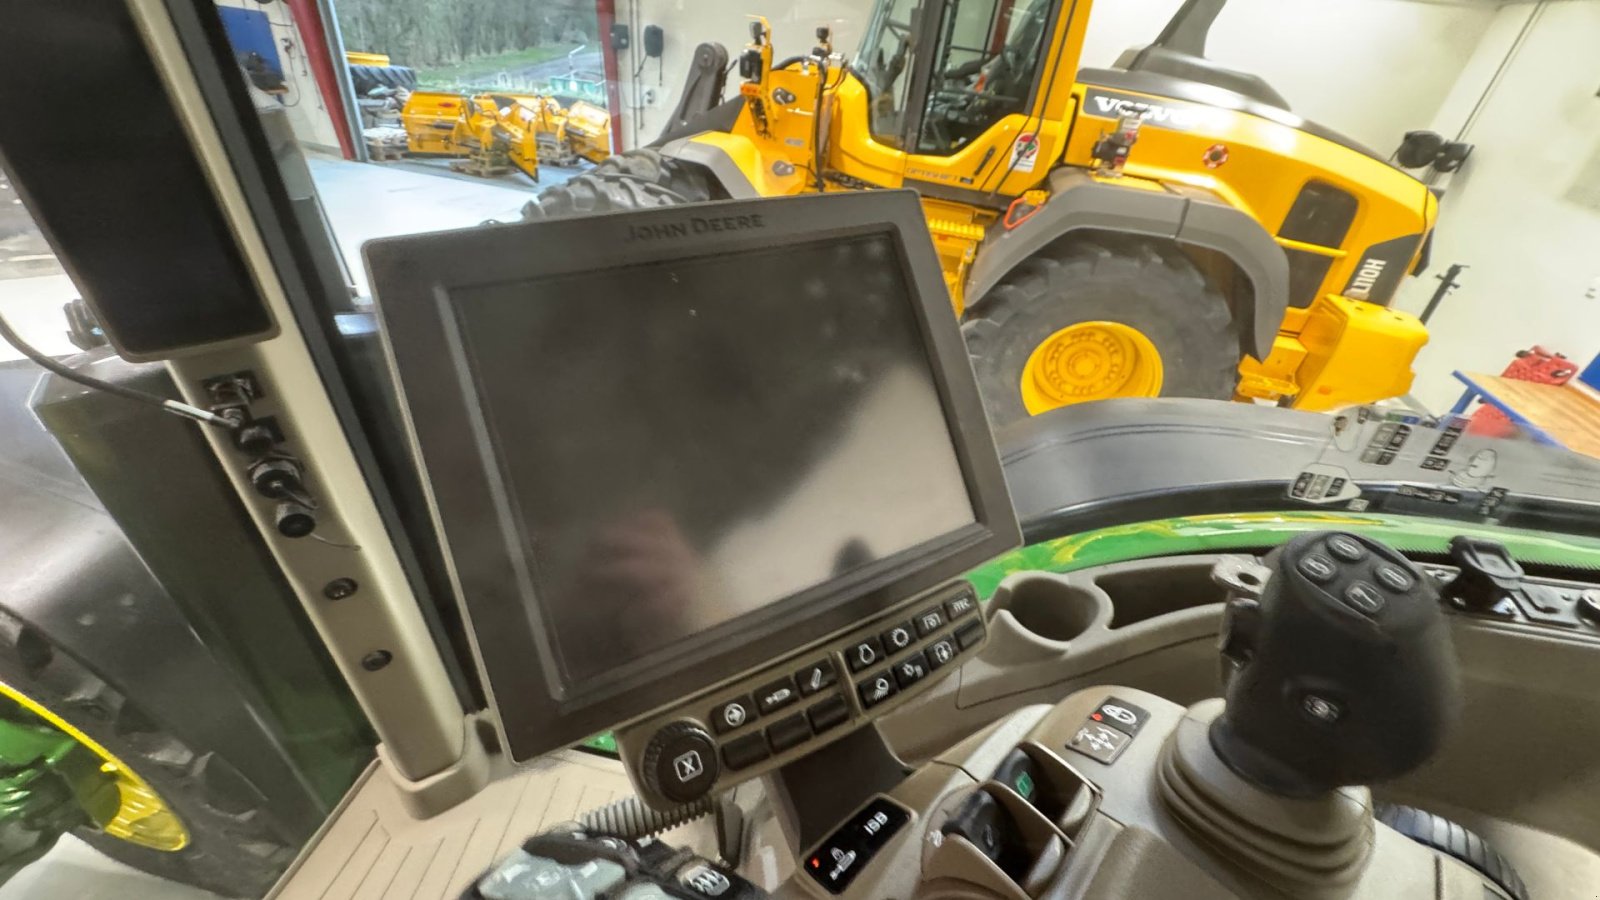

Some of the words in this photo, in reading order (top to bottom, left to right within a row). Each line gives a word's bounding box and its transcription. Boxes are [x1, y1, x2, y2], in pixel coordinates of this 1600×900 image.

[1094, 96, 1193, 125] VOV
[624, 222, 688, 244] JOHN
[690, 214, 766, 234] DEERE
